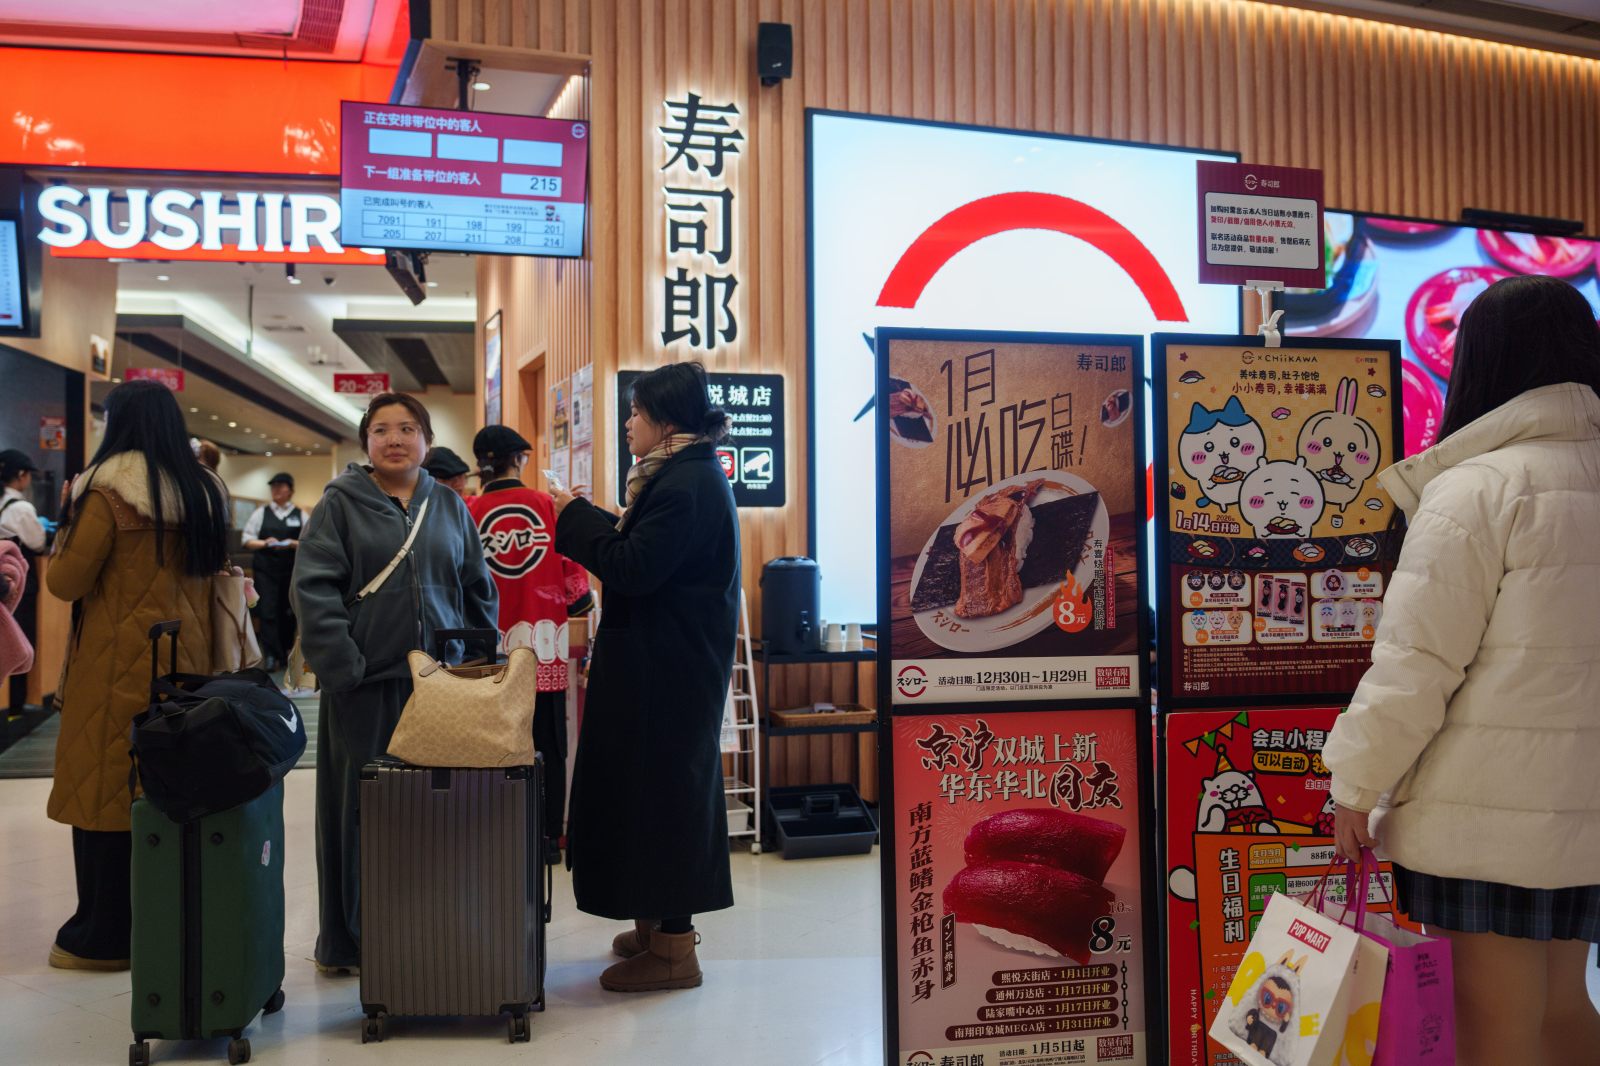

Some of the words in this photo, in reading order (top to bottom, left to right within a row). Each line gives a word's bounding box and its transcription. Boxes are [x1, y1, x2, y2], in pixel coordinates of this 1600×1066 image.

[363, 110, 482, 133] 正在安排带位中的客人
[363, 165, 481, 186] 下一组准备带位的客人
[530, 177, 558, 192] 215
[1261, 179, 1280, 188] 寿司郎
[363, 196, 434, 209] 已完成叫号的客人
[38, 185, 387, 256] SUSHIR
[378, 215, 401, 225] 7091
[425, 218, 442, 228] 191
[466, 220, 482, 230] 198
[506, 222, 522, 232] 199
[544, 225, 560, 235] 201
[658, 92, 744, 350] 寿司郎
[383, 229, 401, 239] 205
[425, 231, 442, 241] 207
[465, 233, 482, 243] 211
[544, 237, 560, 247] 214
[1076, 353, 1127, 373] 寿司郎
[940, 349, 995, 417] 1月
[707, 384, 772, 406] 悦城店
[944, 399, 1048, 504] 必吃
[1175, 510, 1240, 534] 1月14日开始
[481, 530, 549, 553] スシロー
[930, 610, 970, 633] スシロー
[1058, 601, 1086, 625] 8元
[896, 676, 929, 687] スシロー
[1097, 676, 1129, 687] 售完即止
[1183, 681, 1210, 691] 寿司郎
[916, 719, 1098, 772] 京沪双城上新
[1252, 729, 1331, 751] 会员小程
[1257, 753, 1306, 771] 可以自动
[938, 760, 1123, 812] 华东华北同庆
[1253, 849, 1282, 858] 生日当月
[908, 801, 935, 1004] 南方蓝鳍金枪鱼赤身
[1219, 848, 1245, 943] 生日福利
[1089, 916, 1132, 954] 8元
[1290, 922, 1307, 939] POP
[1304, 929, 1330, 950] MART
[1190, 989, 1198, 1018] HAPPY
[1032, 1039, 1085, 1055] 1月5日起
[940, 1054, 985, 1066] 寿司郎
